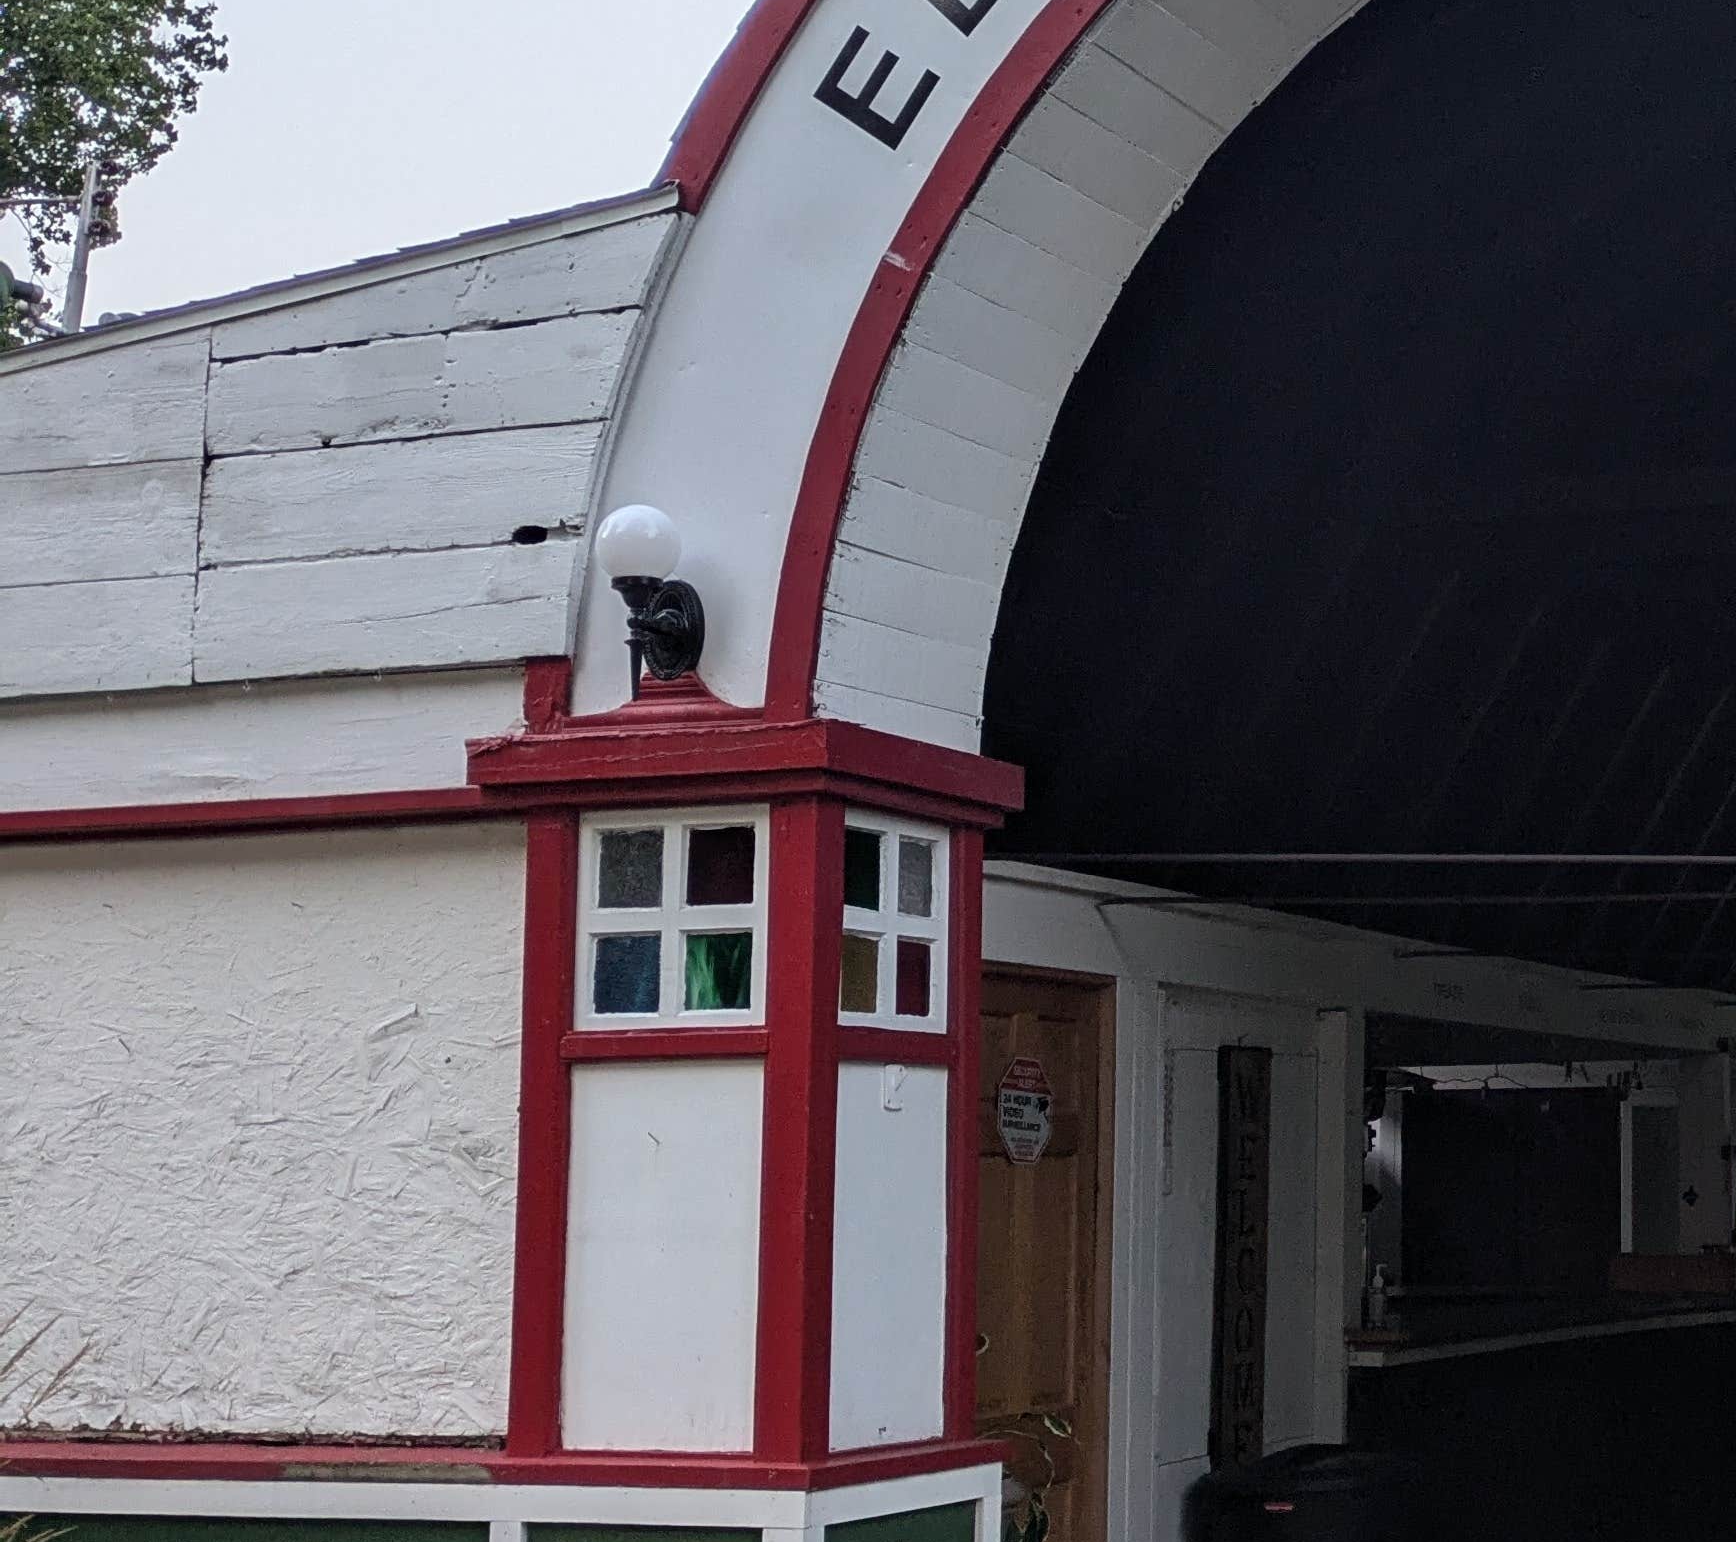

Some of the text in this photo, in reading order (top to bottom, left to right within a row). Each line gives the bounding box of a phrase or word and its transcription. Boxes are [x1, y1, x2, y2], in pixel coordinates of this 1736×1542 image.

[1003, 1093, 1032, 1106] 24 HOUR
[1003, 1106, 1024, 1119] VIDEO
[1002, 1119, 1041, 1133] SURVEILLANCE
